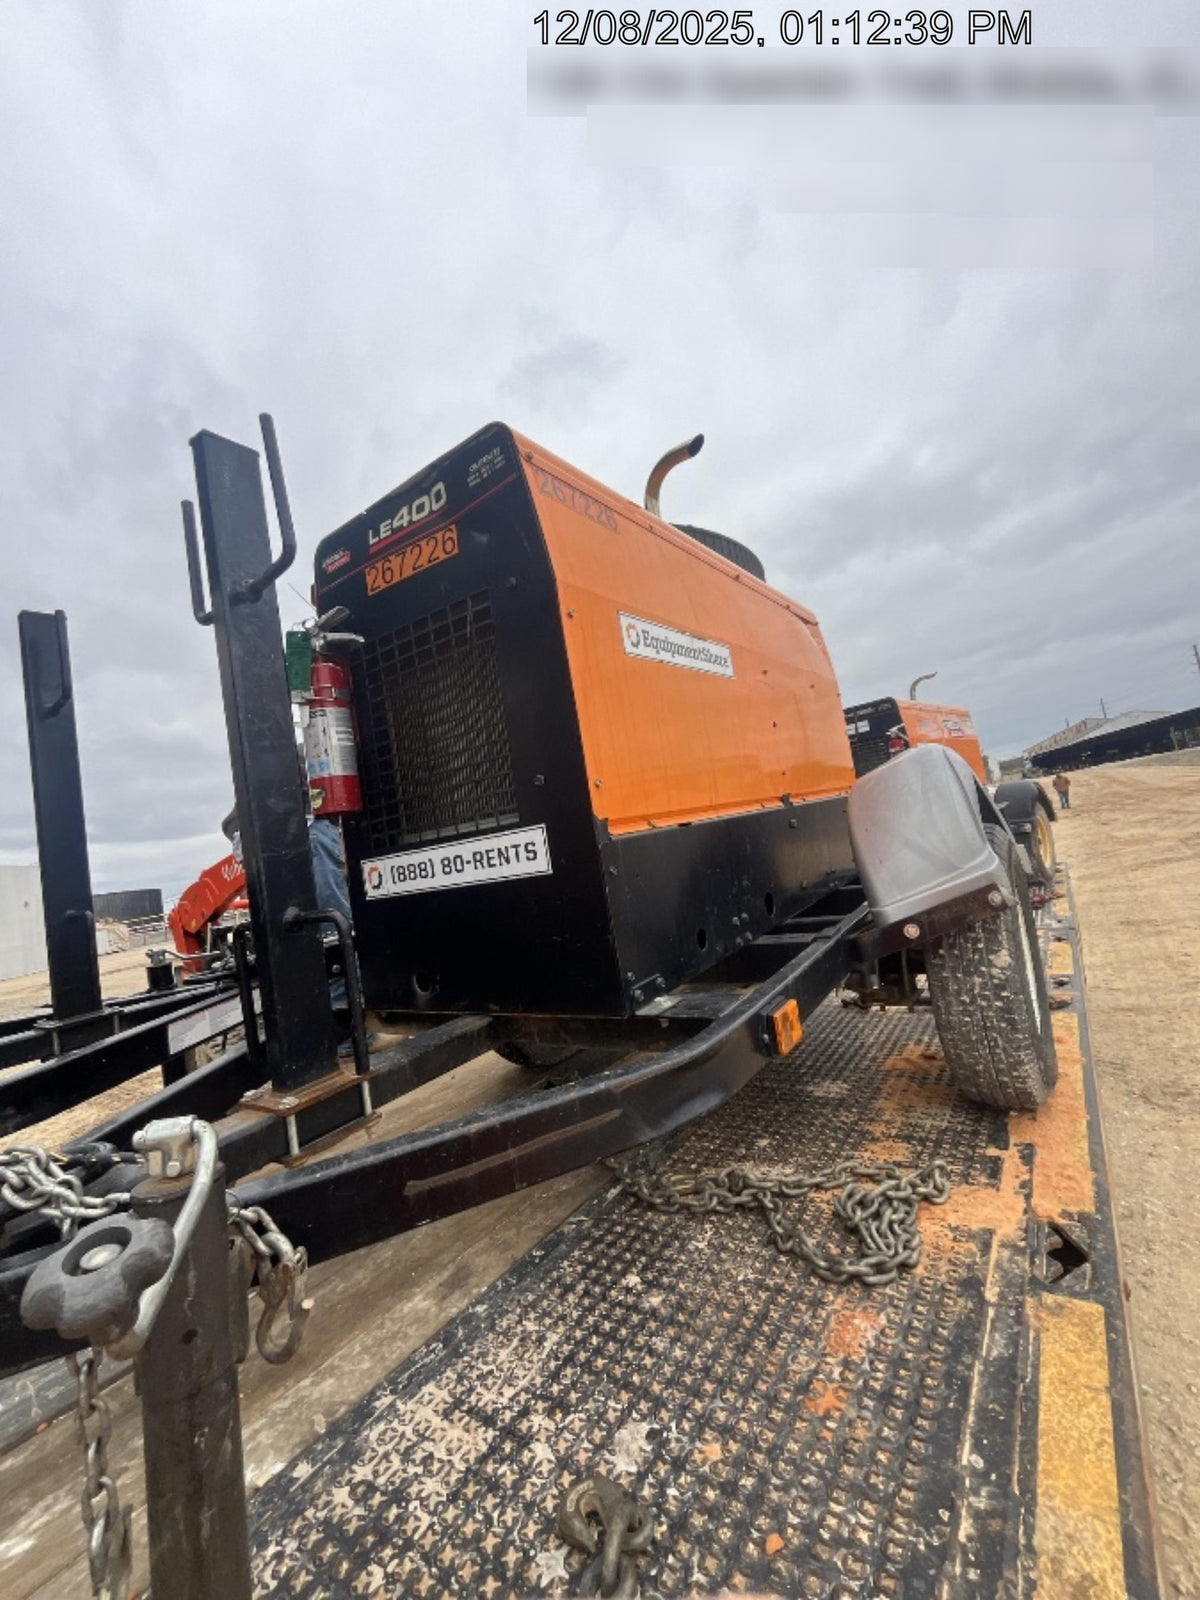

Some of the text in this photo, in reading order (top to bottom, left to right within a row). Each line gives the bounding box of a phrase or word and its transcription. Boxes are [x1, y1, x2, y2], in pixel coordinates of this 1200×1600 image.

[369, 481, 447, 545] LE400
[367, 527, 456, 592] 267226
[390, 841, 538, 885] (888) 80-RENTS
